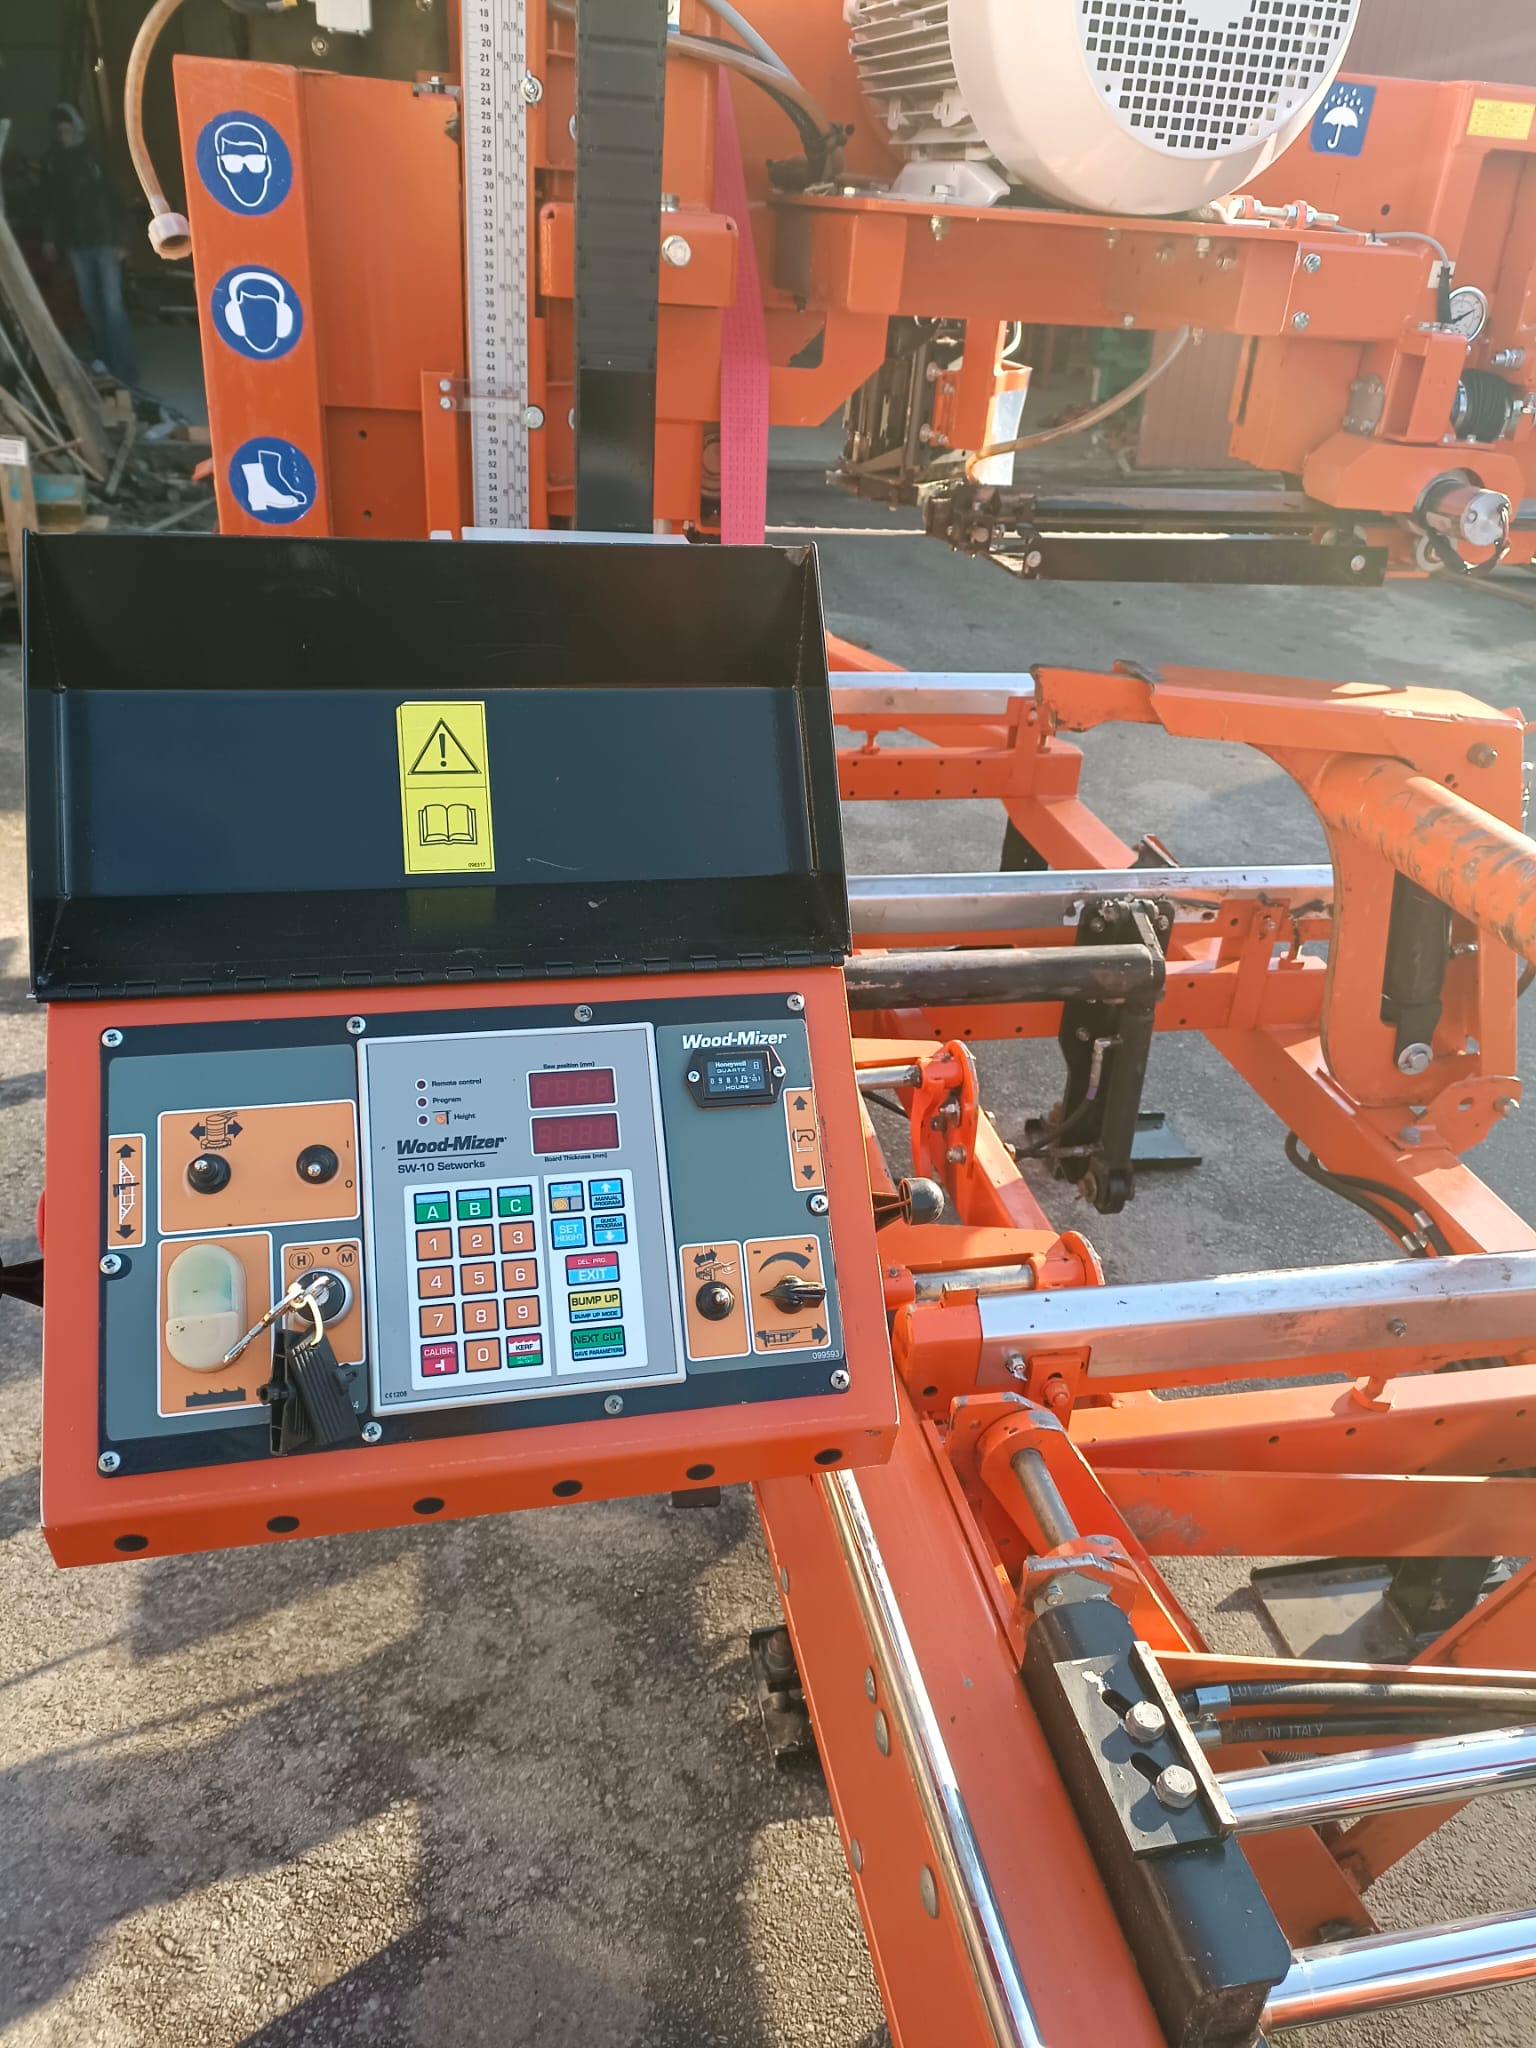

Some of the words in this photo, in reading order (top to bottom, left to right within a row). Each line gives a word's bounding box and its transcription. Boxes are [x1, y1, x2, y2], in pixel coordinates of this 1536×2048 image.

[480, 8, 488, 17] 18
[480, 24, 489, 32] 19
[482, 39, 491, 47] 20
[481, 68, 490, 76] 22
[481, 83, 490, 91] 23
[482, 140, 491, 148] 27
[484, 195, 492, 203] 31
[682, 1031, 787, 1049] Wood-Mizer
[397, 1135, 505, 1155] Wood-Mizer
[398, 1162, 434, 1174] SW-10
[437, 1160, 485, 1171] Setworks
[470, 1203, 480, 1216] B
[510, 1200, 521, 1212] C
[427, 1206, 439, 1219] A
[560, 1225, 578, 1234] SET
[472, 1235, 482, 1247] 2
[513, 1231, 523, 1244] 3
[429, 1238, 437, 1251] 1
[297, 1256, 306, 1265] H
[342, 1253, 352, 1263] M
[474, 1272, 484, 1284] 5
[515, 1268, 526, 1281] 6
[580, 1269, 606, 1279] EXIT
[430, 1276, 442, 1288] 4
[572, 1296, 601, 1306] BUMP
[604, 1294, 618, 1302] UP
[476, 1310, 486, 1323] 8
[518, 1306, 528, 1319] 9
[433, 1314, 444, 1327] 7
[573, 1335, 599, 1344] NEXT
[602, 1332, 621, 1341] CUT
[424, 1347, 455, 1356] CALIBR.
[589, 1347, 623, 1355] PARAMETERS
[1266, 1726, 1281, 1738] IN
[1289, 1723, 1323, 1736] ITALY
